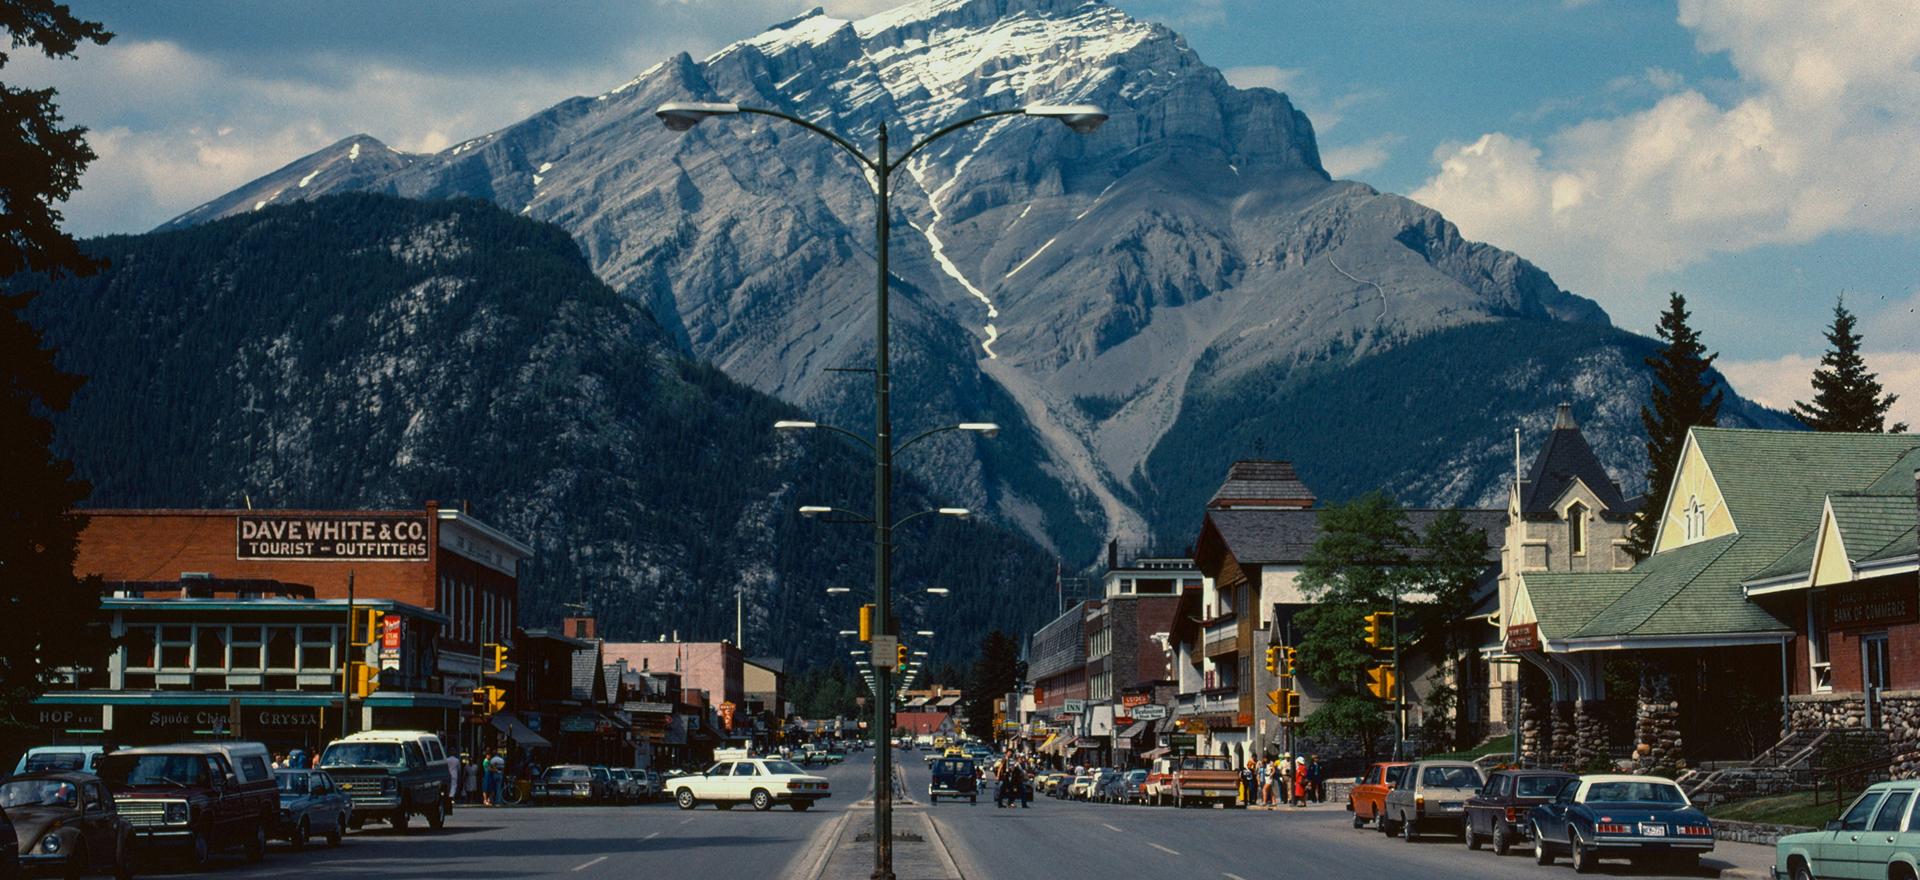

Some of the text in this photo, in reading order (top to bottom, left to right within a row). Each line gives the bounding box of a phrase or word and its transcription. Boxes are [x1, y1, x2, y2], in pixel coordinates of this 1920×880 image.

[242, 521, 427, 541] DAVE WHITE & CO.
[249, 542, 314, 555] TOURIST
[336, 543, 427, 556] OUTFITTERS
[1833, 600, 1906, 623] BANK OF COMMERCE
[149, 711, 190, 727] Spode
[259, 711, 327, 725] CRYSTA
